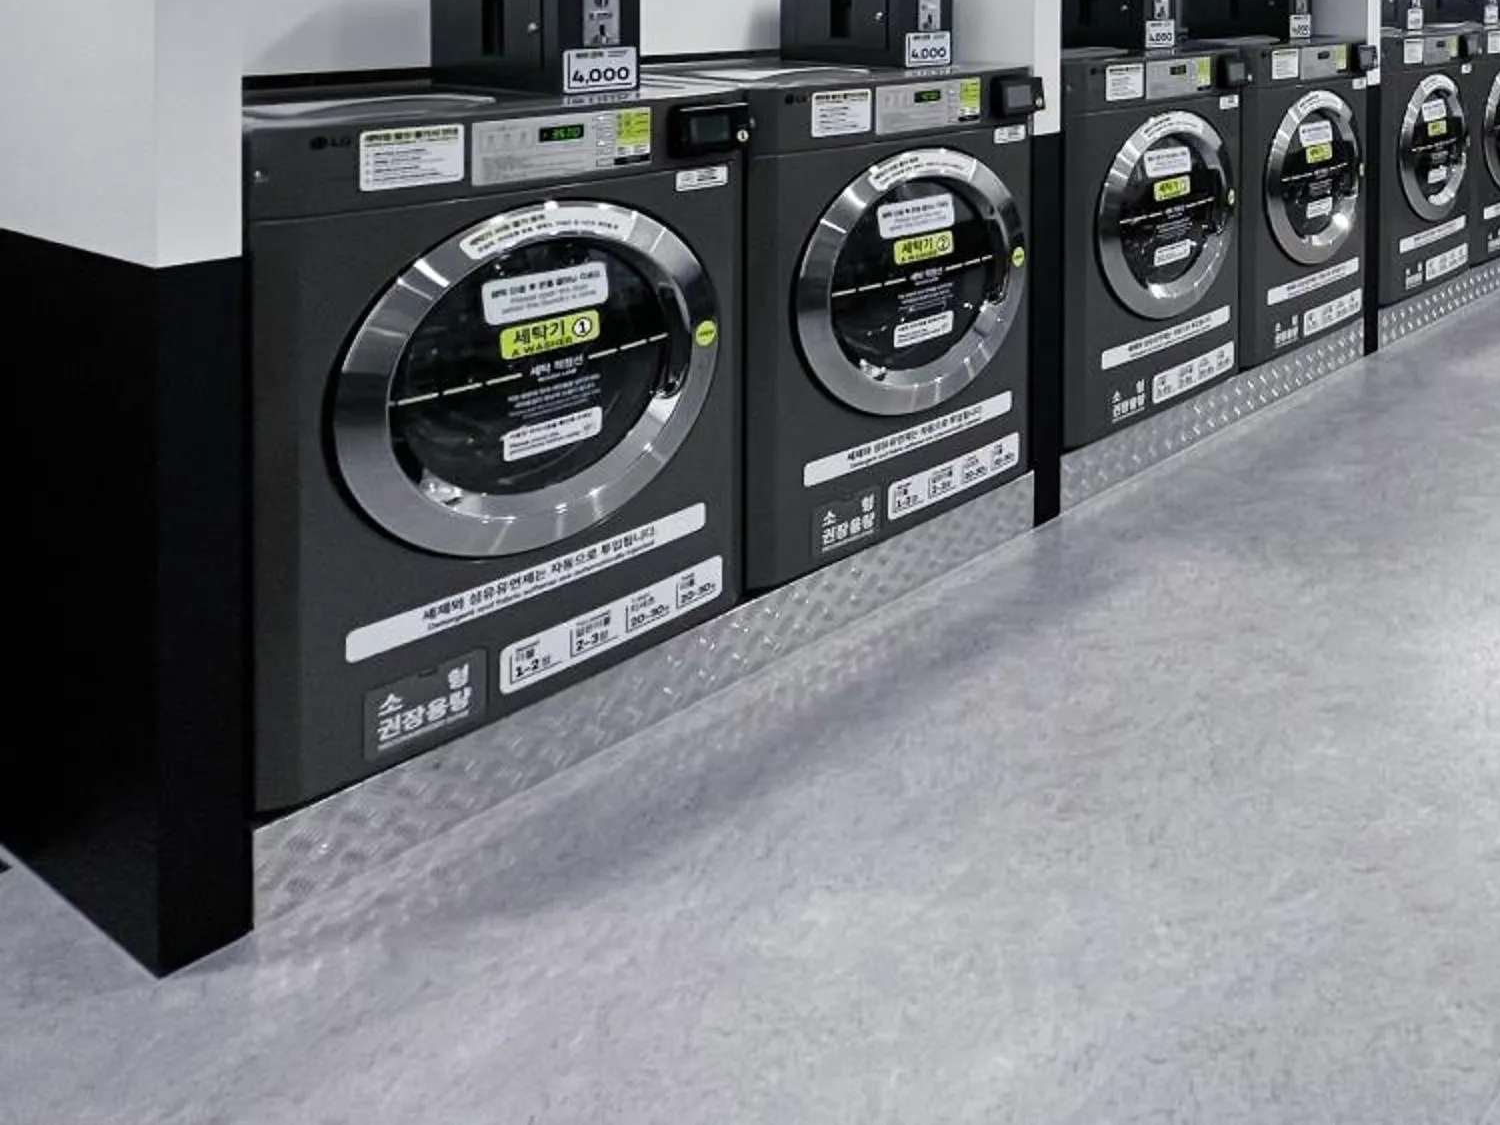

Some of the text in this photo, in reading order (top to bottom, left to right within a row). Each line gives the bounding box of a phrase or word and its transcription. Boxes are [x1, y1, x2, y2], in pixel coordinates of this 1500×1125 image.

[572, 66, 630, 85] 4,000
[514, 319, 565, 344] 세탁기
[822, 510, 837, 527] 소
[422, 527, 655, 620] 세제와 섬유유연제는 자동으로 투입됩니다
[377, 686, 472, 741] 권장용량
[378, 693, 403, 717] 소
